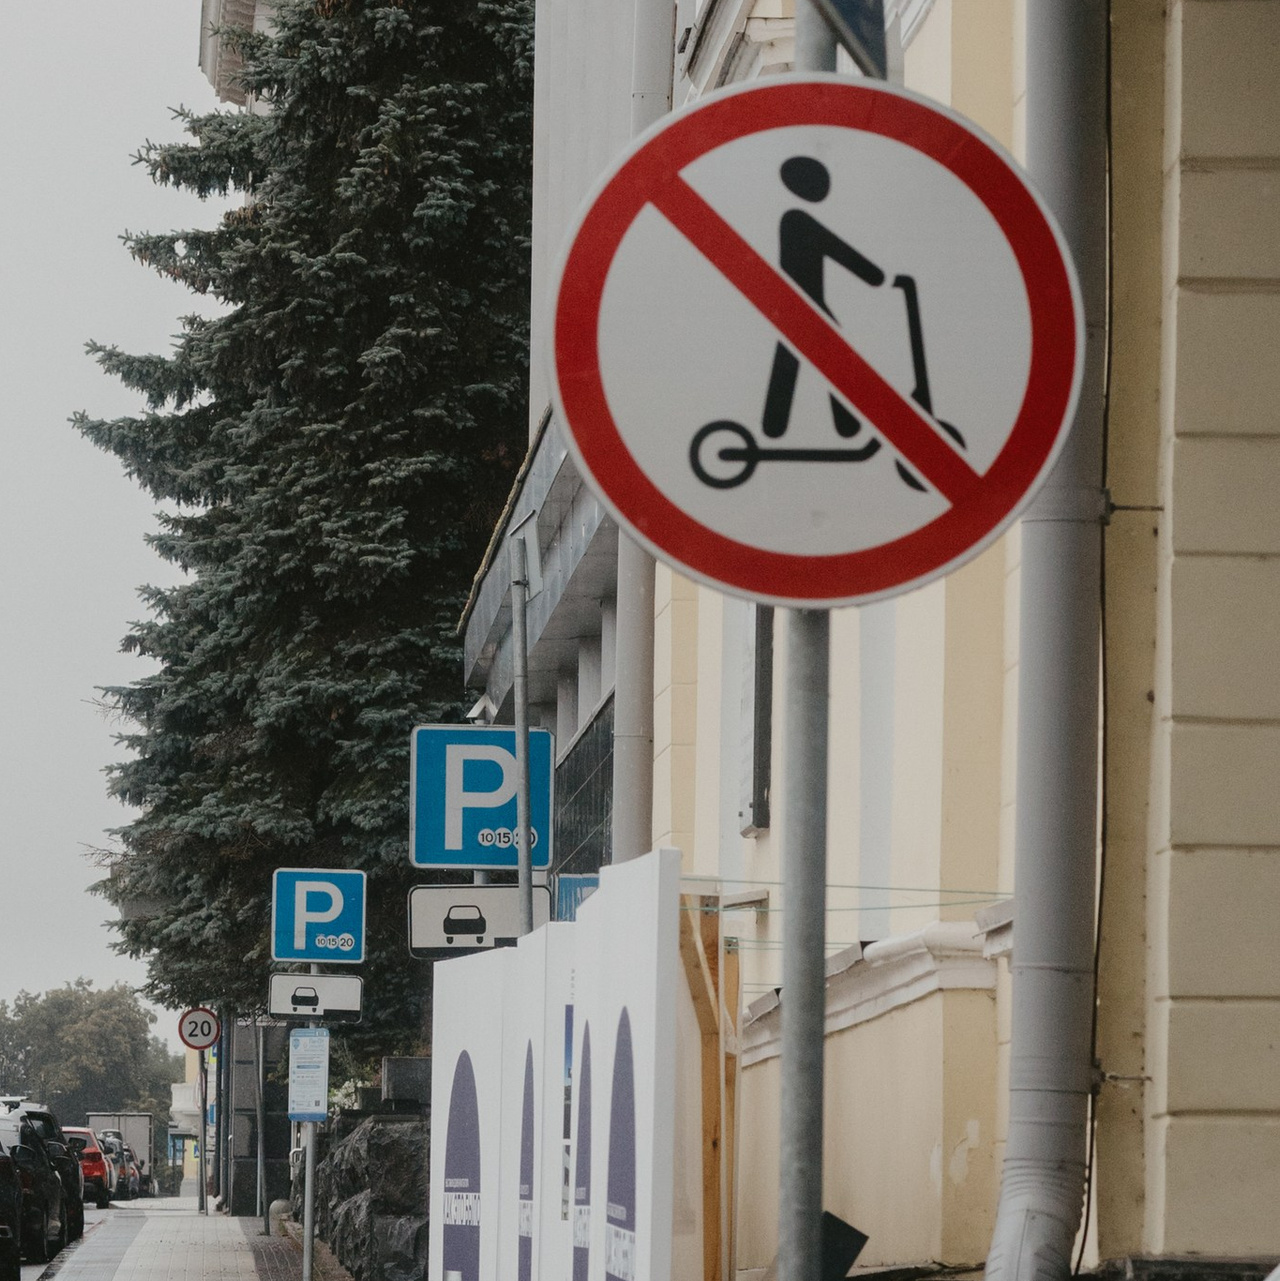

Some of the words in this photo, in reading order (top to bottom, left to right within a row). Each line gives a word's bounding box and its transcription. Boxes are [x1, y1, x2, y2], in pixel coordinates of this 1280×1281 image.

[445, 744, 519, 850] P
[480, 833, 494, 843] 10
[498, 832, 511, 844] 15
[294, 881, 344, 950] P
[317, 938, 326, 946] 10
[328, 937, 337, 946] 15
[340, 937, 353, 948] 20
[188, 1020, 212, 1038] 20
